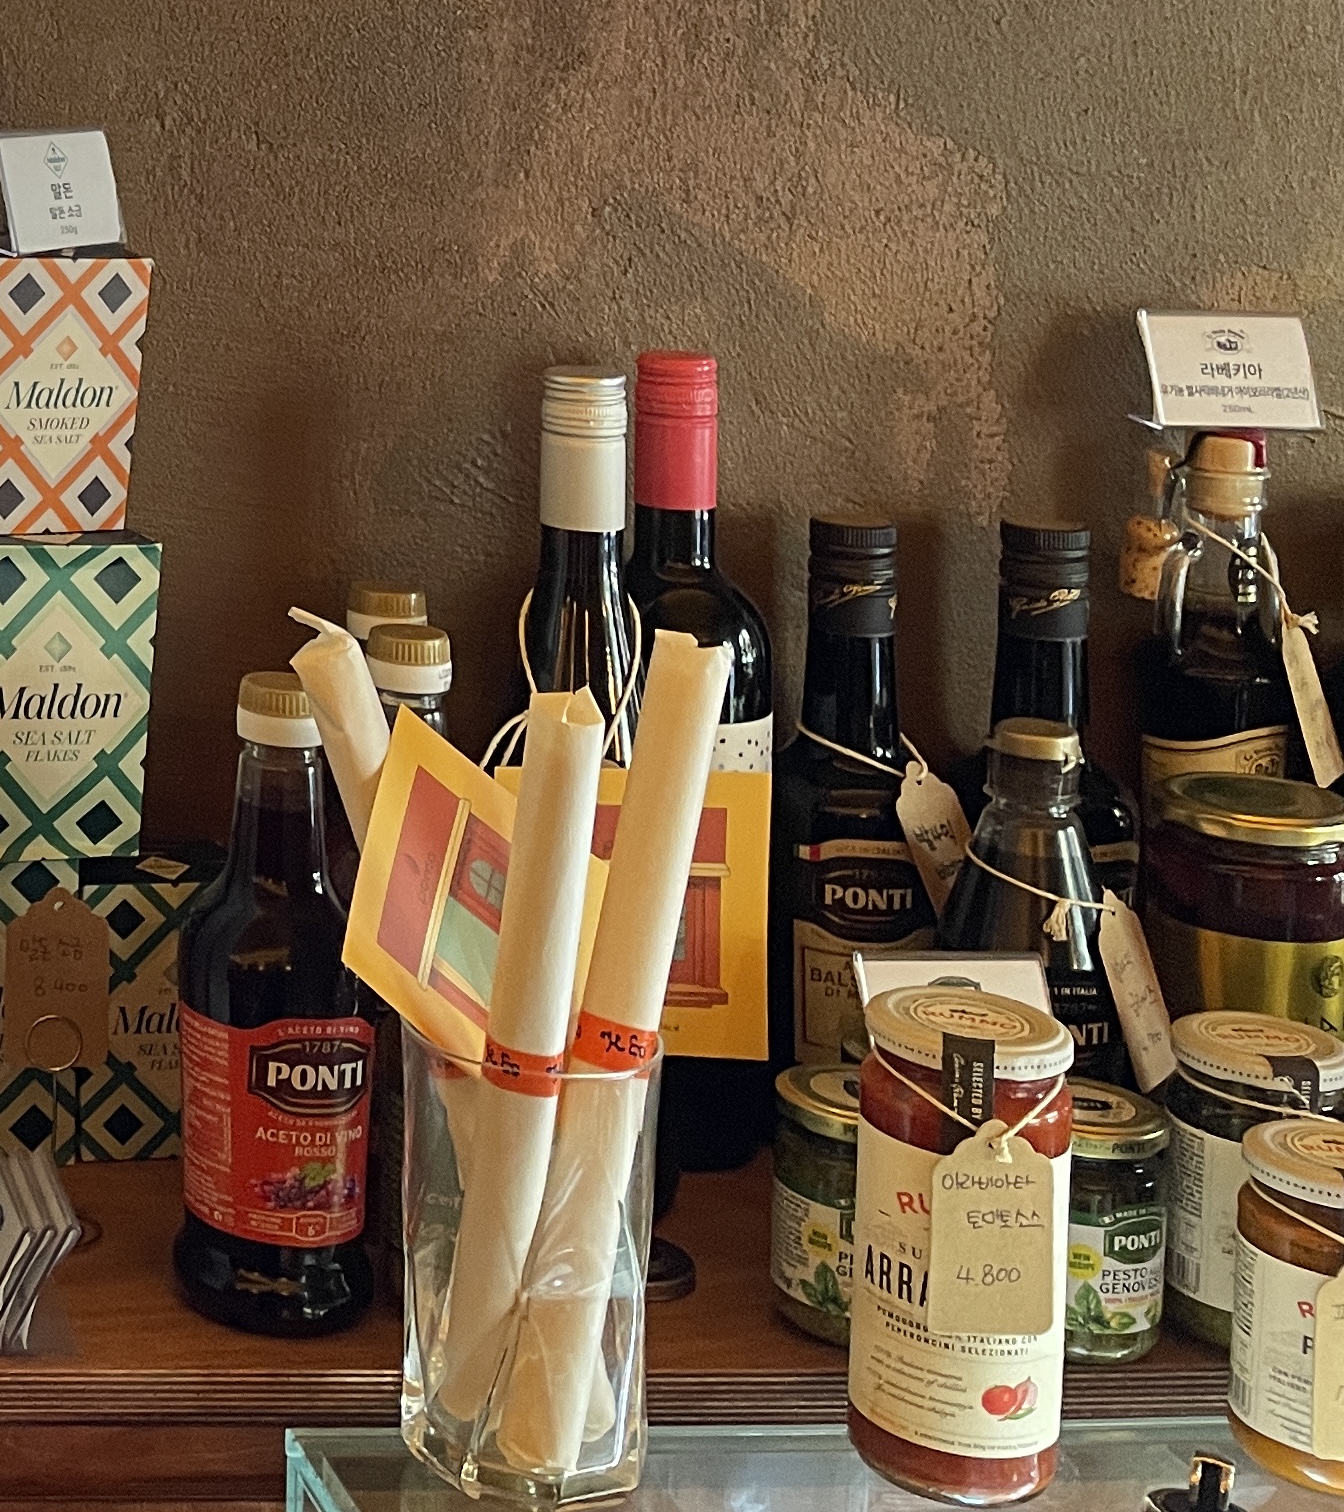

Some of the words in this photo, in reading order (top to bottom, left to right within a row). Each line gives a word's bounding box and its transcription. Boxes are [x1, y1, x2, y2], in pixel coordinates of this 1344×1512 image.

[50, 181, 74, 201] 말돈
[1199, 361, 1263, 380] 라베키아
[4, 377, 114, 411] Maldon
[27, 417, 90, 432] SMOKED
[31, 434, 53, 445] SEA
[55, 434, 83, 445] SALT
[11, 730, 48, 746] SEA
[52, 729, 97, 746] SALT
[24, 749, 81, 763] FLAKES
[824, 883, 912, 911] PONTI
[921, 1009, 1019, 1031] RUMMO
[301, 1040, 341, 1055] 1787
[266, 1058, 365, 1091] PONTI
[971, 1061, 985, 1105] SELECTED
[971, 1106, 984, 1121] BY
[255, 1126, 312, 1147] ACETO
[315, 1132, 332, 1146] DI
[335, 1124, 363, 1144] VINO
[294, 1145, 338, 1158] ROSSO
[941, 1171, 1037, 1191] 아라비아타
[1113, 1228, 1161, 1252] PONTI
[1101, 1266, 1148, 1282] PESTO
[966, 1334, 1018, 1347] ITALIANO
